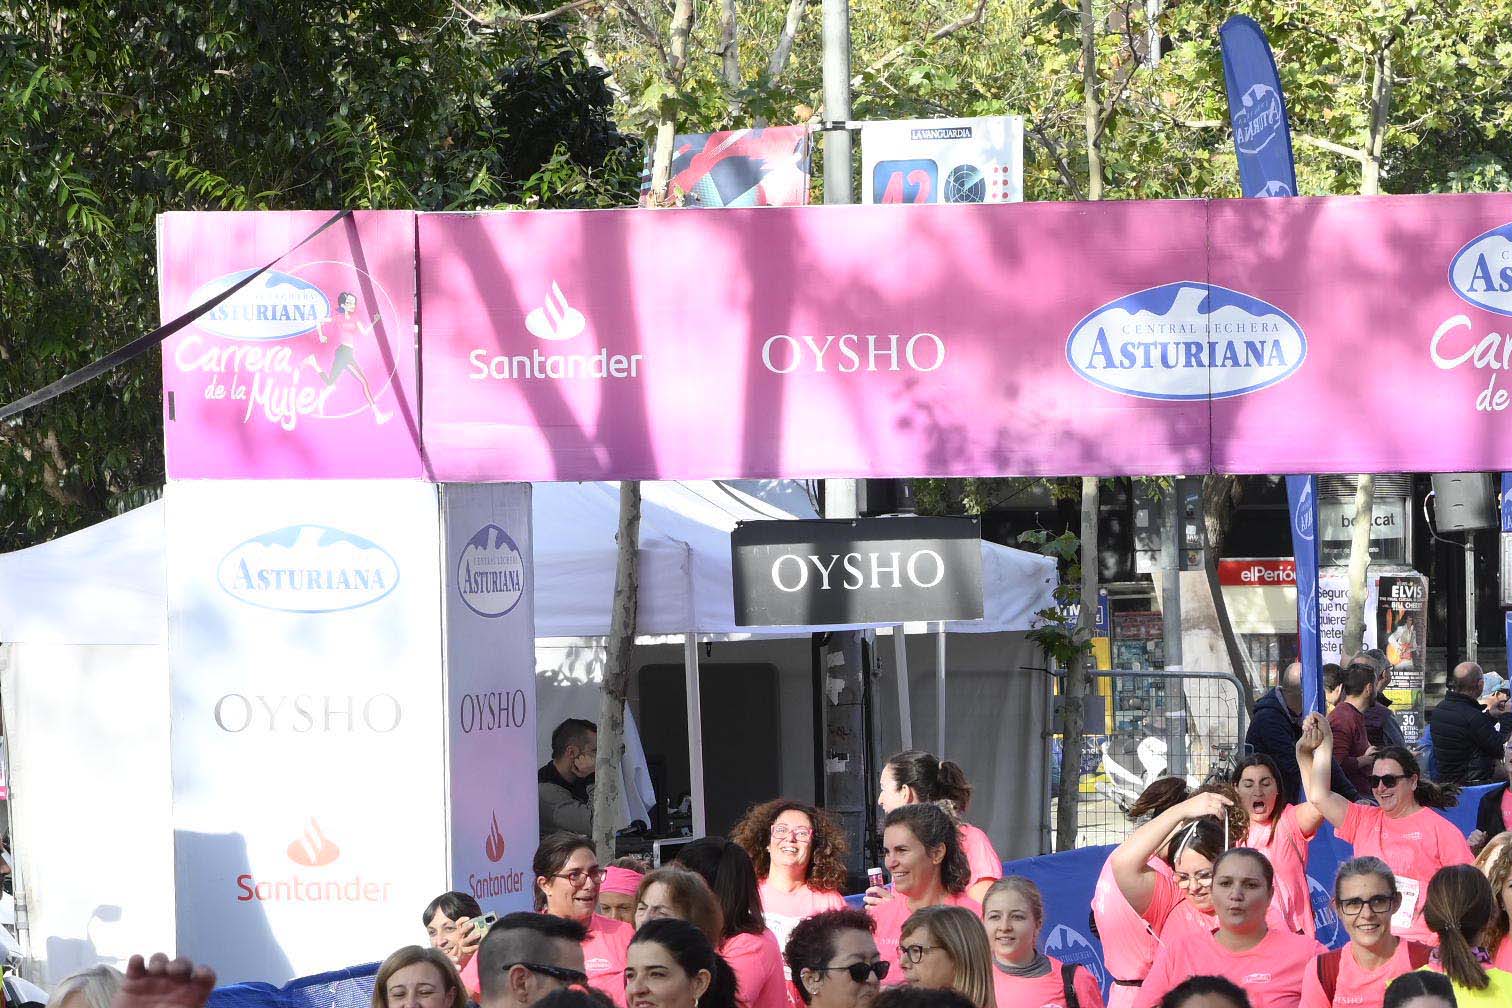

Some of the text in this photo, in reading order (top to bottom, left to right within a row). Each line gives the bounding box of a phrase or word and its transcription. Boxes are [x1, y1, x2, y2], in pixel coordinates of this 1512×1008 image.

[1122, 322, 1280, 334] CENTRAL LECHERA
[174, 335, 293, 374] Carrera
[469, 347, 643, 380] Santander
[761, 332, 947, 374] OYSHO
[1084, 326, 1288, 369] ASTURIANA
[204, 368, 338, 431] de la Mujer
[1475, 374, 1511, 411] de
[231, 556, 386, 591] ASTURIANA
[462, 558, 521, 593] ASTURIANA
[770, 548, 946, 593] OYSHO
[1391, 585, 1423, 598] ELVIS
[214, 692, 402, 733] OYSHO
[460, 688, 526, 734] OYSHO
[236, 873, 392, 903] Santander
[467, 868, 525, 900] Santander
